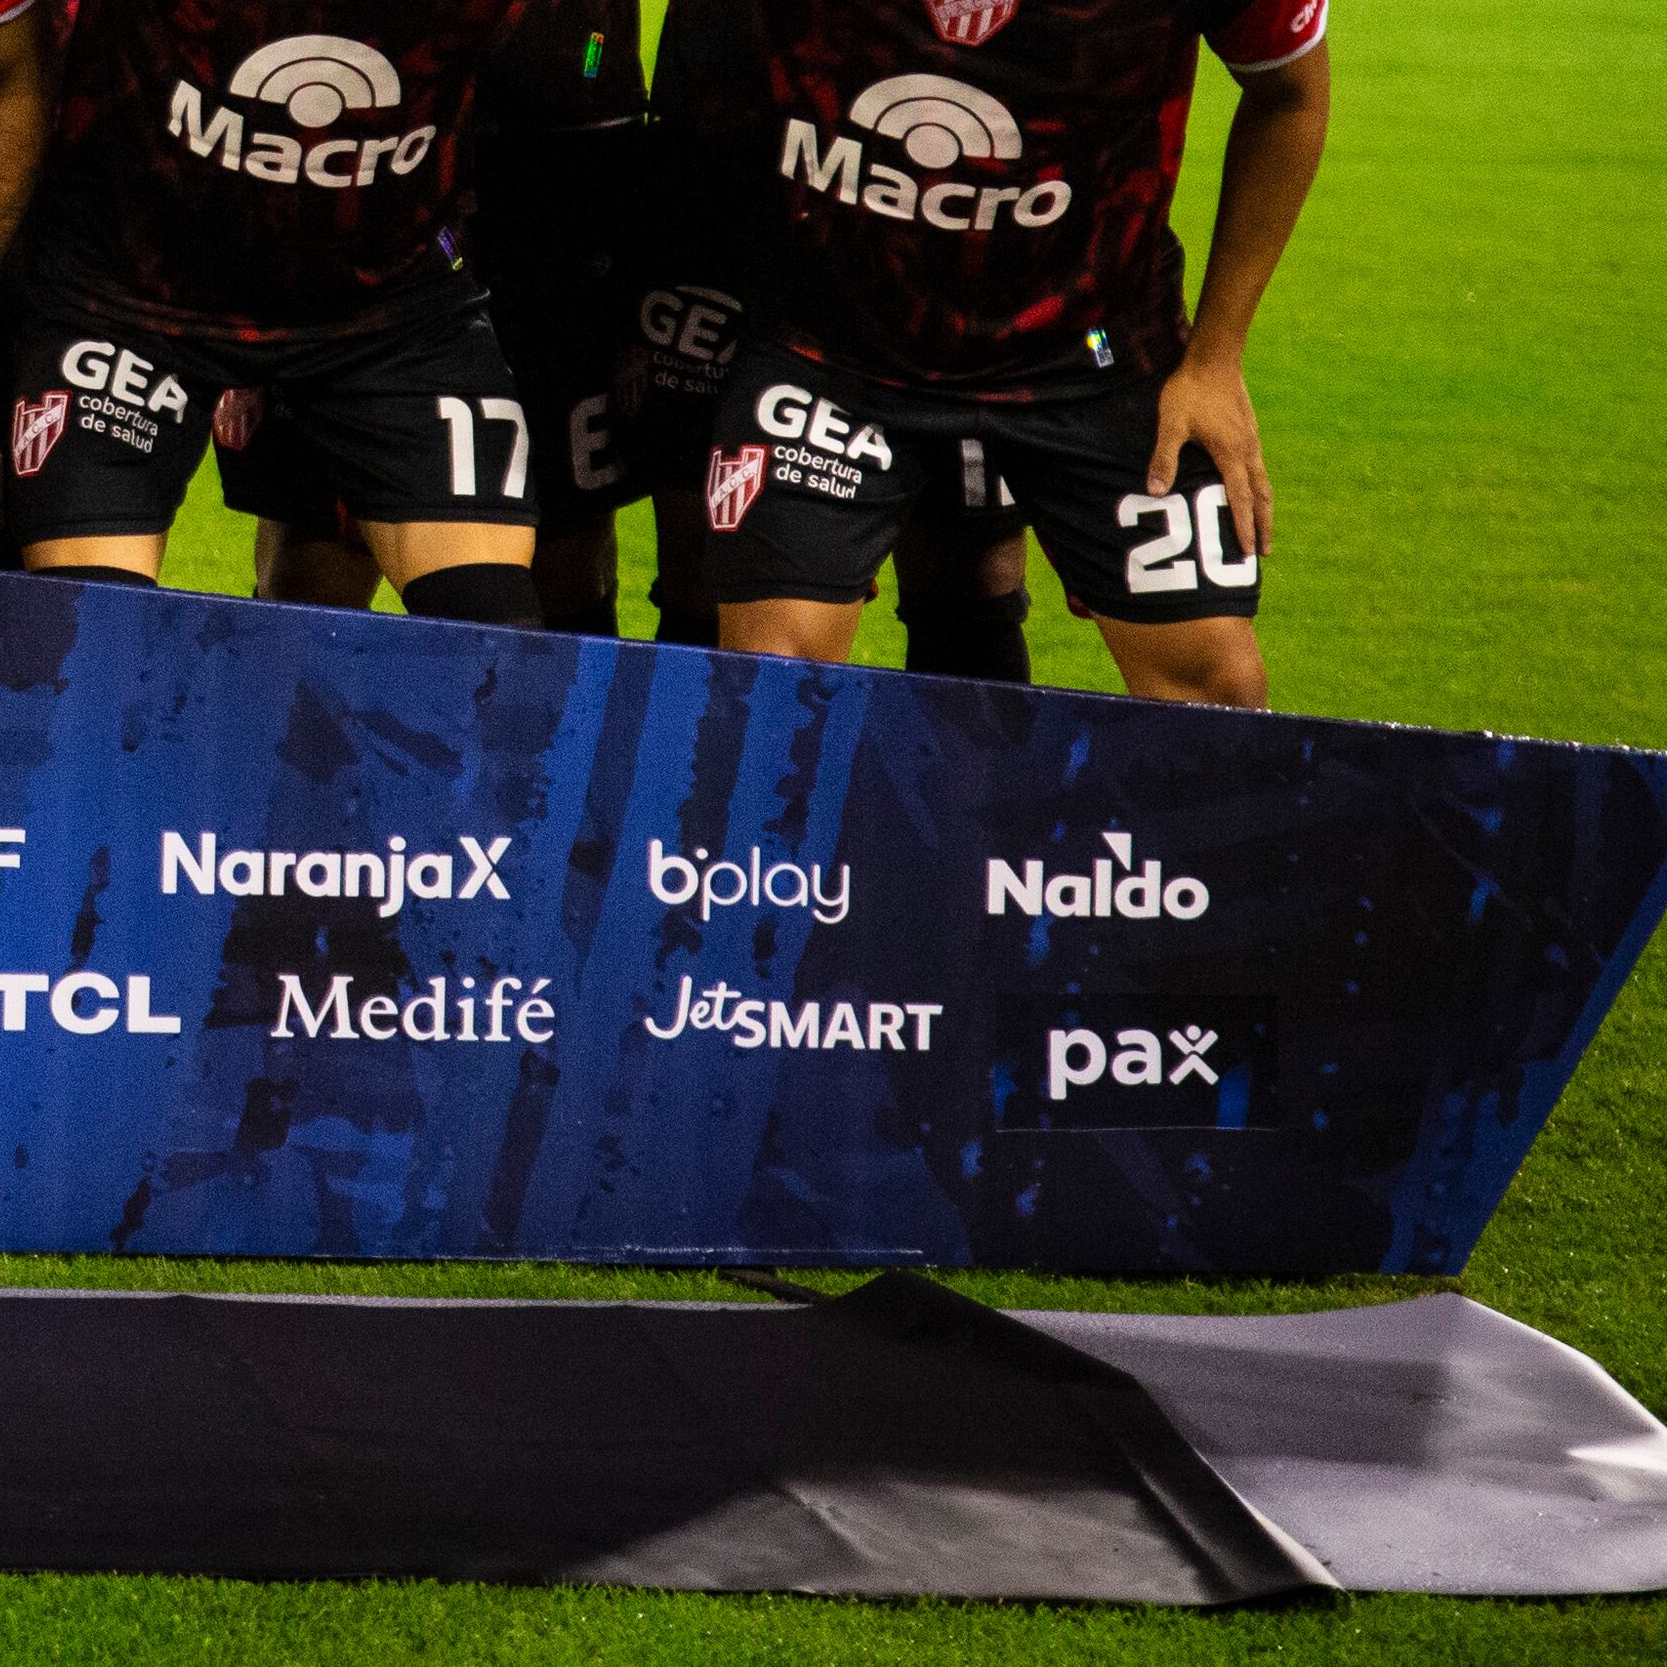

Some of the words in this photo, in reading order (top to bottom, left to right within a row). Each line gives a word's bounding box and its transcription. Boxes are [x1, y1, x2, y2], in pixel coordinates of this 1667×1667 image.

[167, 79, 437, 189] Macro
[779, 118, 1072, 232] Macro
[62, 340, 189, 425] GEA
[79, 395, 159, 437] cobertura
[81, 413, 107, 433] de
[111, 424, 154, 454] salud
[438, 395, 530, 499] 17
[756, 384, 894, 472] GEA
[774, 445, 863, 485] cobertura
[776, 463, 802, 484] de
[807, 474, 857, 500] salud
[161, 832, 513, 918] NaranjaX
[987, 832, 1210, 920] Naldo
[270, 974, 556, 1043] Medifé
[645, 975, 944, 1052] JetSMART
[1048, 1024, 1219, 1100] pax
